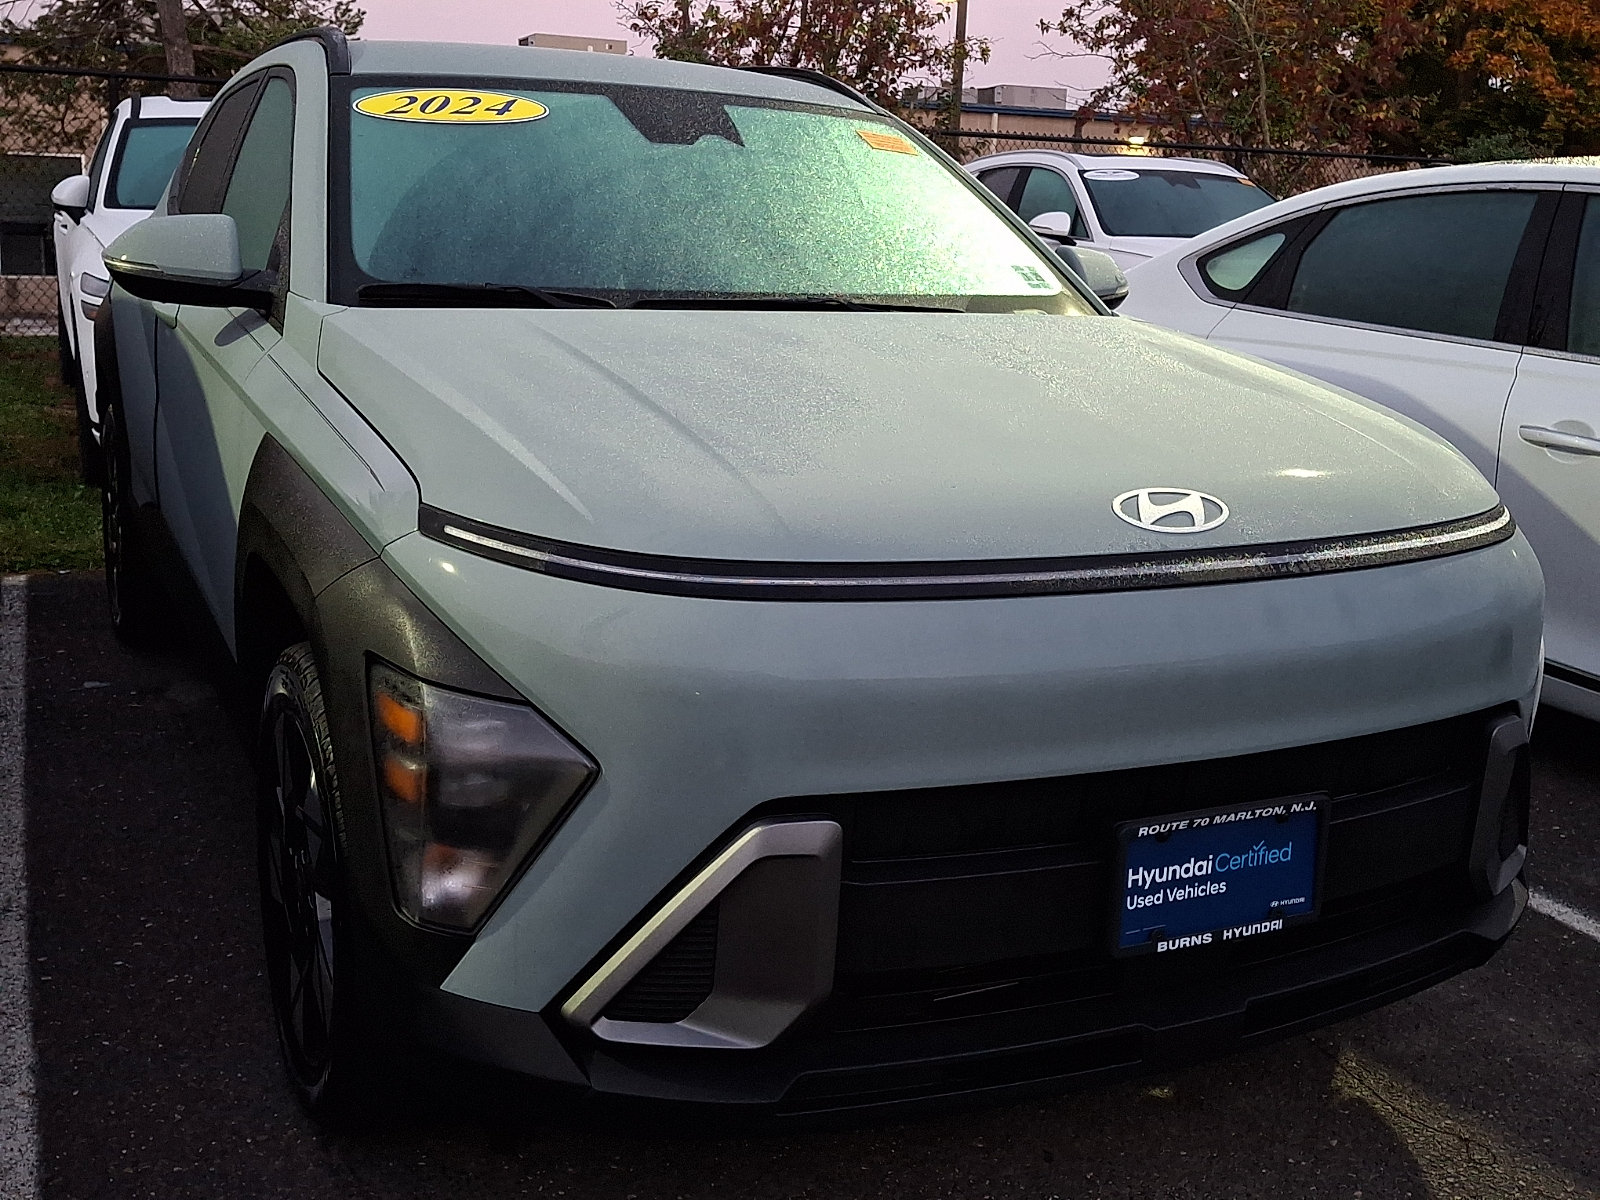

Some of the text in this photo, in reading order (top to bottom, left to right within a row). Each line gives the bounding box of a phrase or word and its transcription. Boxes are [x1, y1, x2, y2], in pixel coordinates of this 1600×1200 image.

[384, 96, 518, 115] 2024
[1138, 801, 1317, 837] ROUTE 70 MARLTON, N.J.
[1127, 841, 1293, 889] Hyundai Certified
[1126, 880, 1227, 910] Used Vehicles
[1280, 897, 1305, 905] HYUNDAI
[1157, 919, 1284, 953] BURNS HYUNDAI
